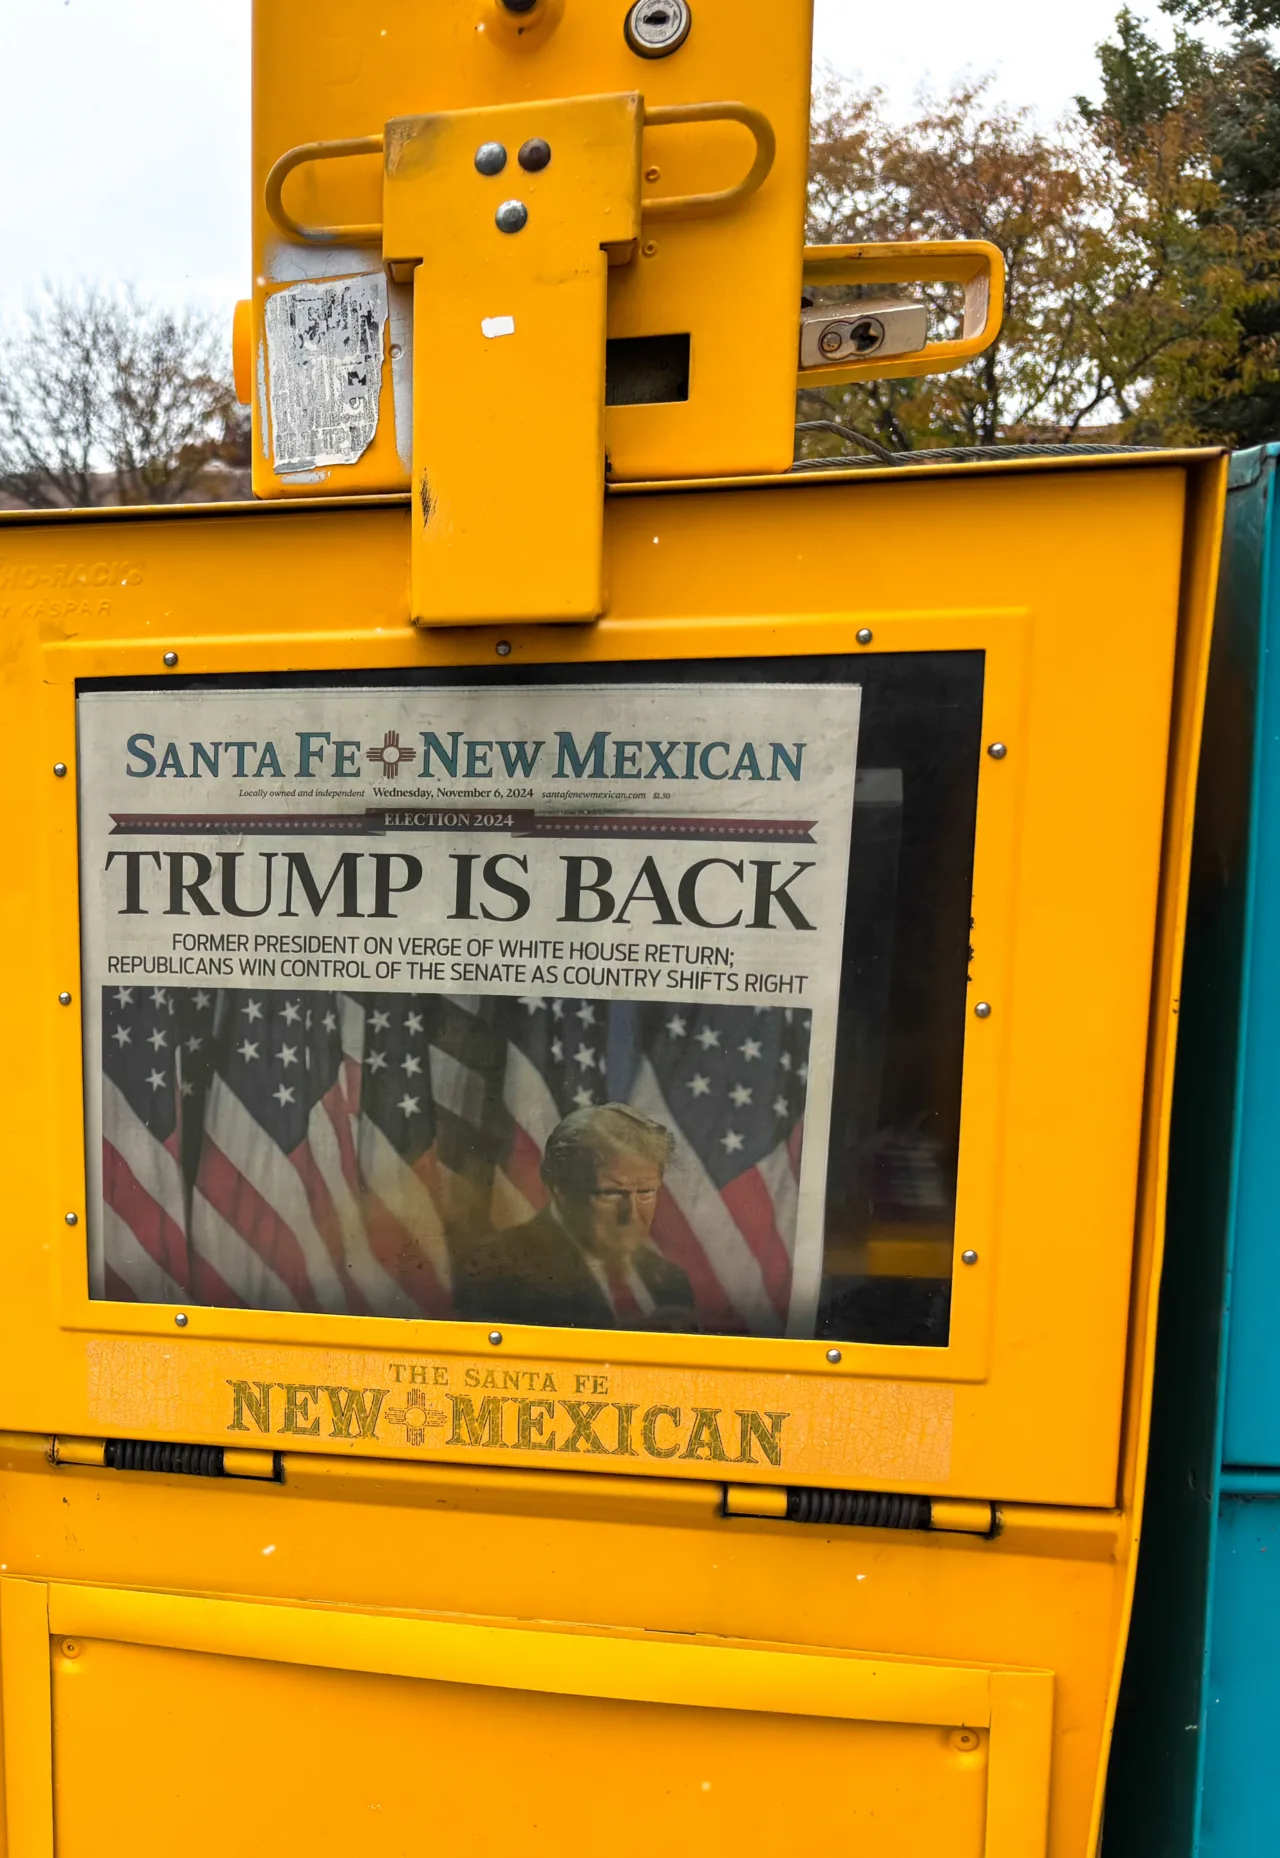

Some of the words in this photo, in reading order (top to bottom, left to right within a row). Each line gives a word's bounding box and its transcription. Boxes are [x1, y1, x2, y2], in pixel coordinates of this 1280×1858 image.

[22, 599, 112, 619] KASPAR
[125, 733, 286, 779] SANTA
[294, 731, 361, 779] FE
[418, 731, 546, 779] NEW
[552, 731, 807, 781] MEXICAN
[239, 789, 268, 799] Locally
[269, 789, 296, 798] owned
[297, 789, 314, 798] and
[315, 789, 365, 799] independent
[372, 787, 434, 799] Wednesday,
[437, 787, 491, 798] November
[493, 788, 504, 799] 6,
[506, 788, 534, 798] 2024
[542, 790, 647, 800] santafenewmexican.com
[652, 792, 671, 800] $1.50
[384, 812, 470, 827] ELECTION
[473, 813, 515, 827] 2024
[104, 850, 423, 918] TRUMP
[446, 852, 531, 922] IS
[556, 854, 818, 931] BACK
[172, 933, 249, 952] FORMER
[254, 934, 360, 954] PRESIDENT
[363, 936, 392, 955] ON
[398, 937, 462, 957] VERGE
[466, 938, 494, 957] OF
[498, 939, 564, 960] WHITE
[569, 941, 640, 962] HOUSE
[644, 943, 735, 969] RETURN;
[108, 955, 234, 975] REPUBLICANS
[239, 957, 276, 977] WIN
[280, 959, 371, 979] CONTROL
[375, 961, 402, 979] OF
[406, 961, 445, 980] THE
[450, 963, 526, 983] SENATE
[531, 965, 559, 984] AS
[563, 966, 661, 988] COUNTRY
[666, 969, 739, 992] SHIFTS
[745, 973, 809, 994] RIGHT
[389, 1363, 449, 1386] THE
[464, 1368, 558, 1393] SANTA
[575, 1374, 609, 1395] FE
[226, 1379, 390, 1440] NEW
[445, 1393, 791, 1466] MEXICAN
